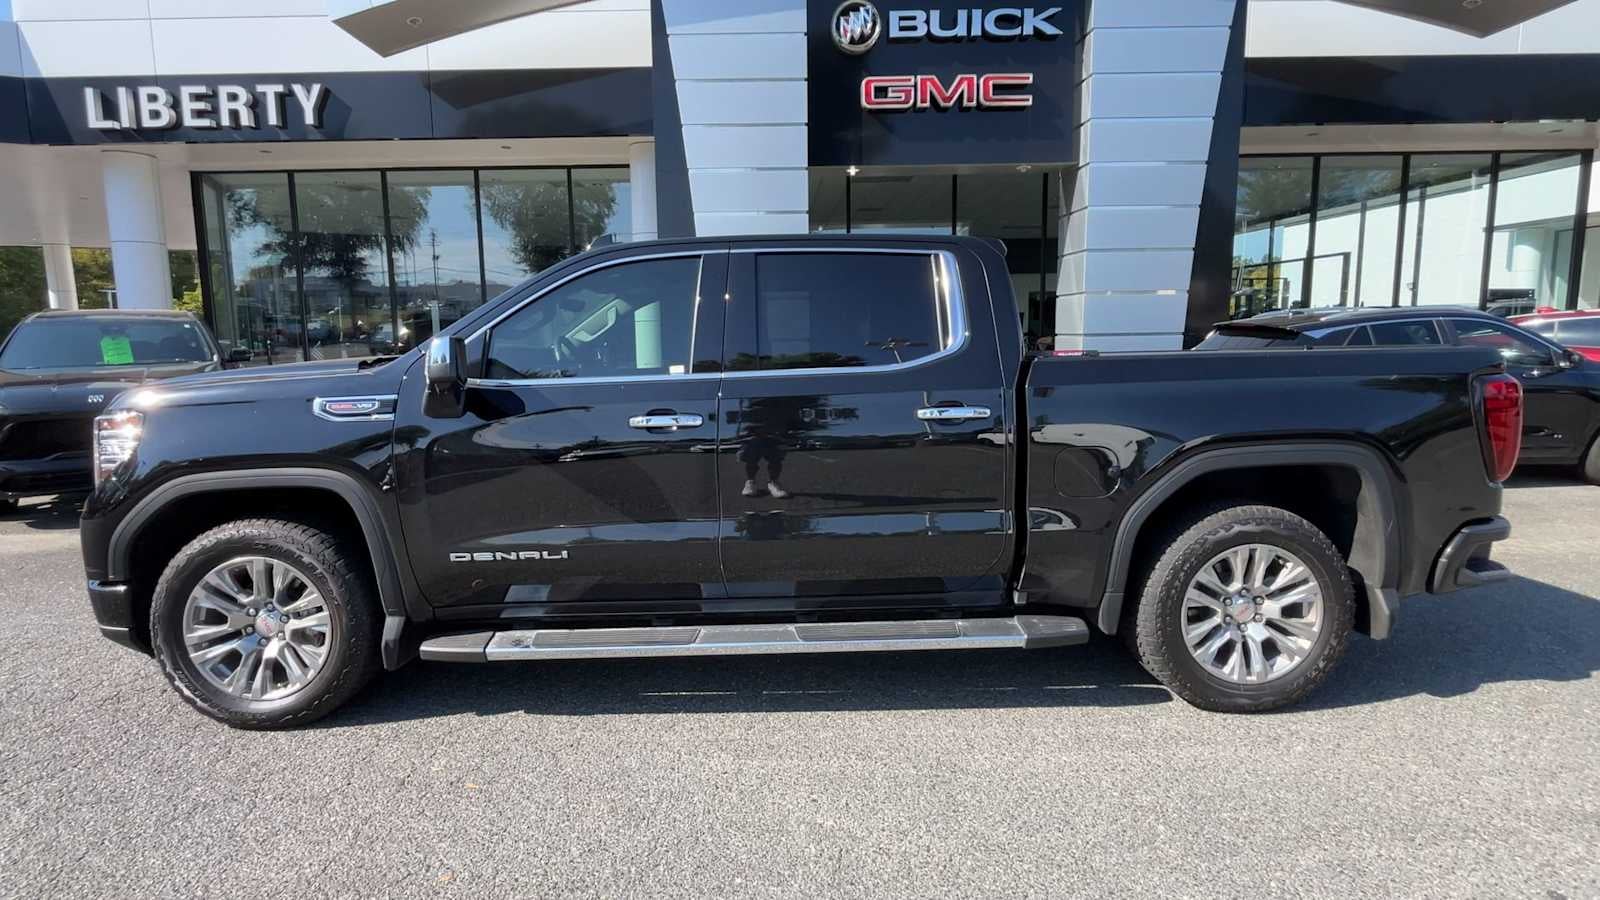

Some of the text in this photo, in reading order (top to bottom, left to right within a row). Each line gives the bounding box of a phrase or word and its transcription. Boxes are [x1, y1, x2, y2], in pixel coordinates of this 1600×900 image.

[889, 7, 1063, 38] BUICK
[84, 83, 322, 129] LIBERTY
[861, 73, 1034, 109] GMC
[449, 550, 568, 562] DENALI
